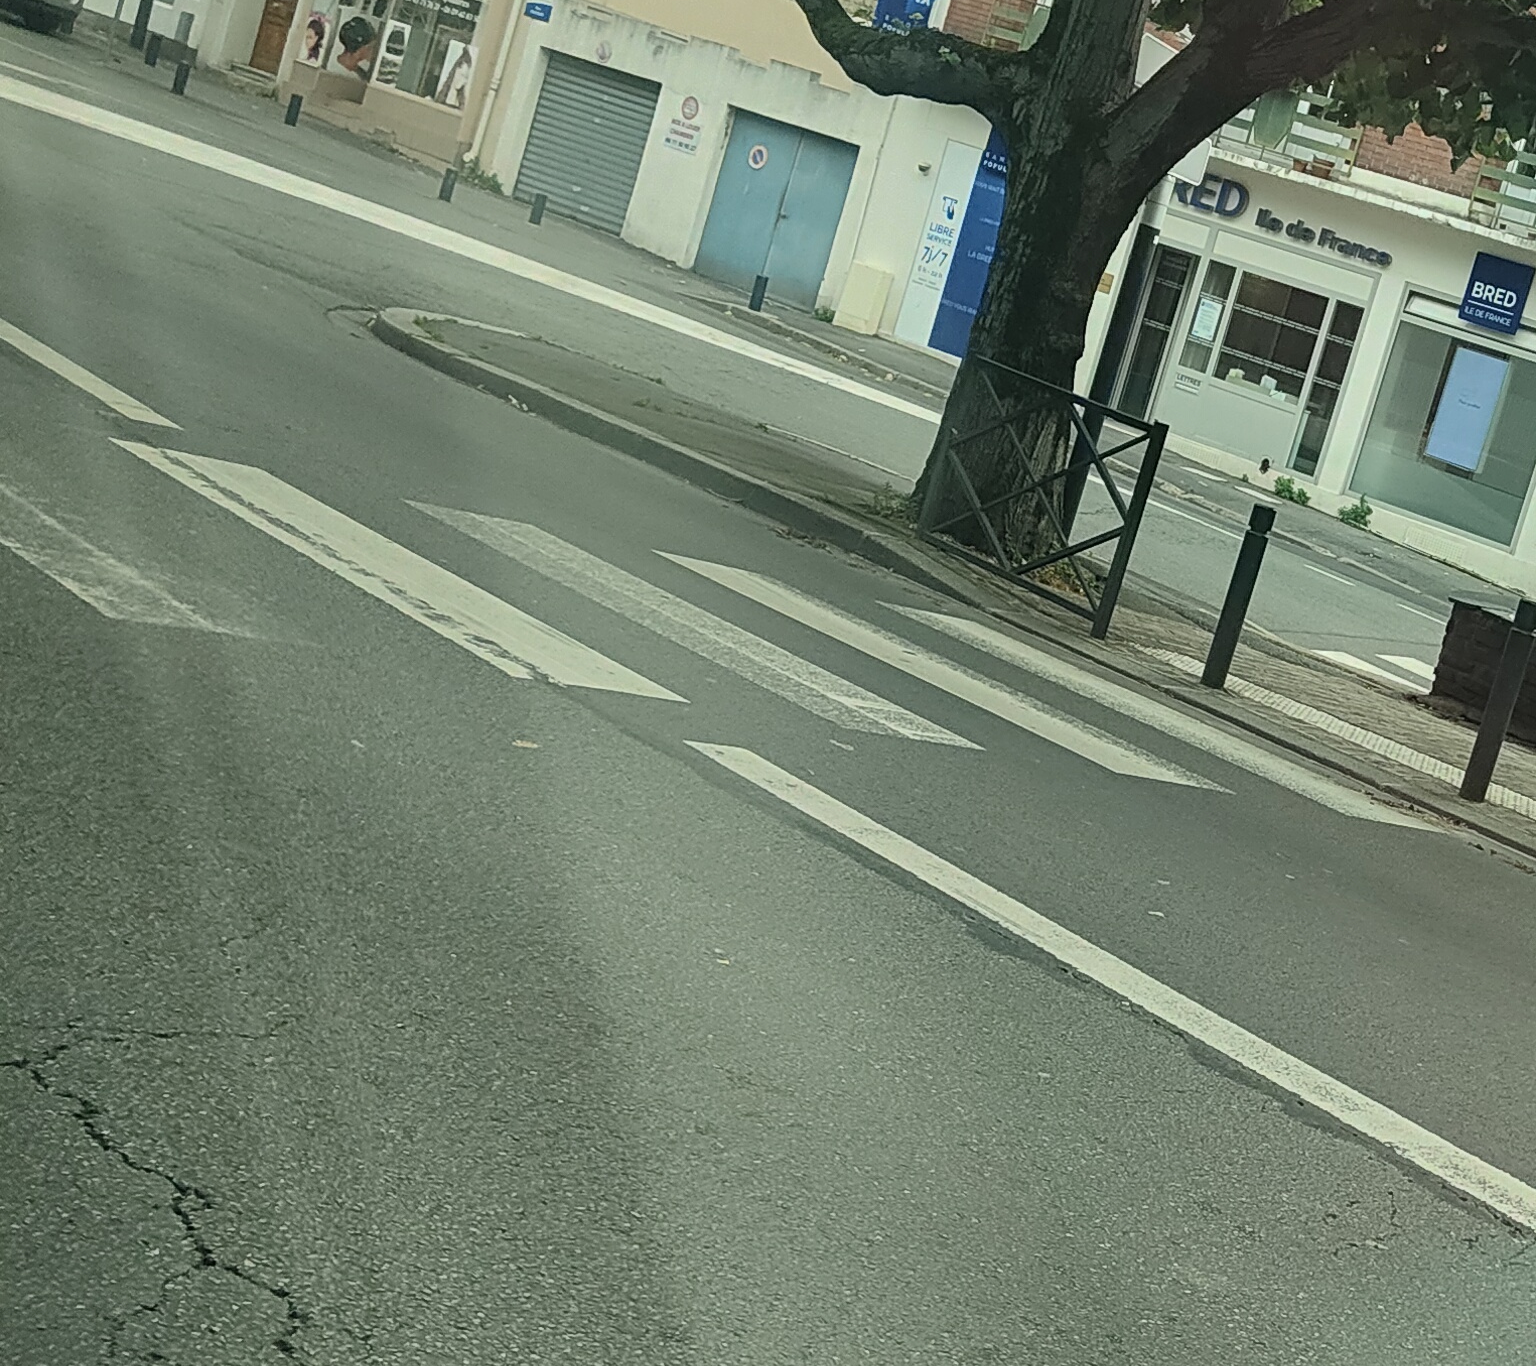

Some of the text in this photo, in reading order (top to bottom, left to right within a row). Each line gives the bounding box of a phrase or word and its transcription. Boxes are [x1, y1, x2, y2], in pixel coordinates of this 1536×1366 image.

[983, 159, 1007, 173] POPUL
[1174, 171, 1250, 218] RED
[926, 233, 953, 247] SERVICE
[929, 222, 955, 239] LIBRE
[1285, 219, 1316, 243] de
[1317, 227, 1393, 267] France
[920, 245, 949, 267] 7j/7
[1471, 280, 1517, 308] BRED
[1475, 308, 1485, 319] DE
[1484, 312, 1512, 327] FRANCE
